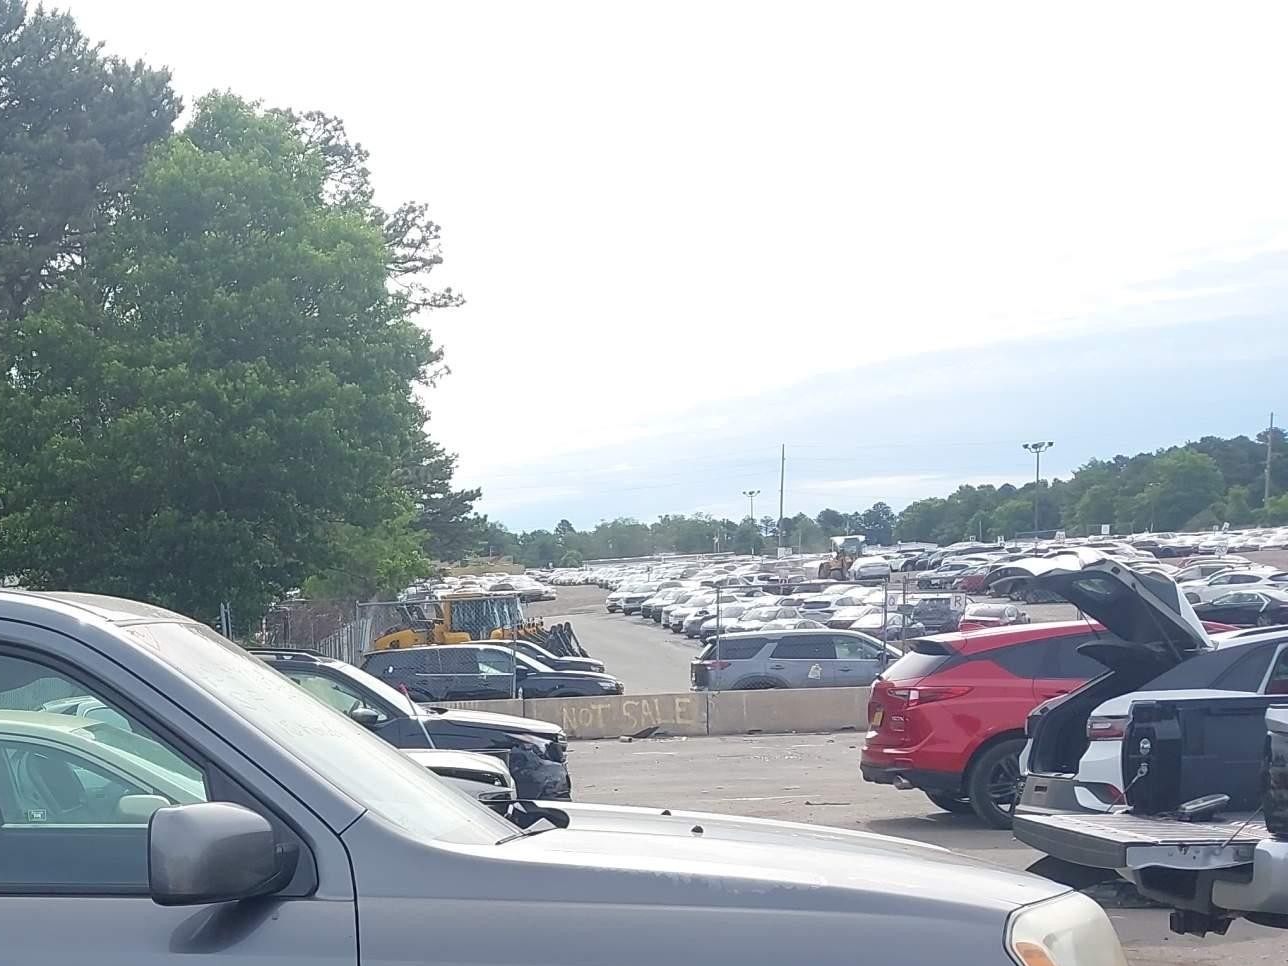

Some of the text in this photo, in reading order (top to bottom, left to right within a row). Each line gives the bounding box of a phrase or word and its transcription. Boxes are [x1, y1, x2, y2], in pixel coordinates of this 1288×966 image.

[954, 595, 962, 608] R
[562, 698, 694, 730] NOT SALE
